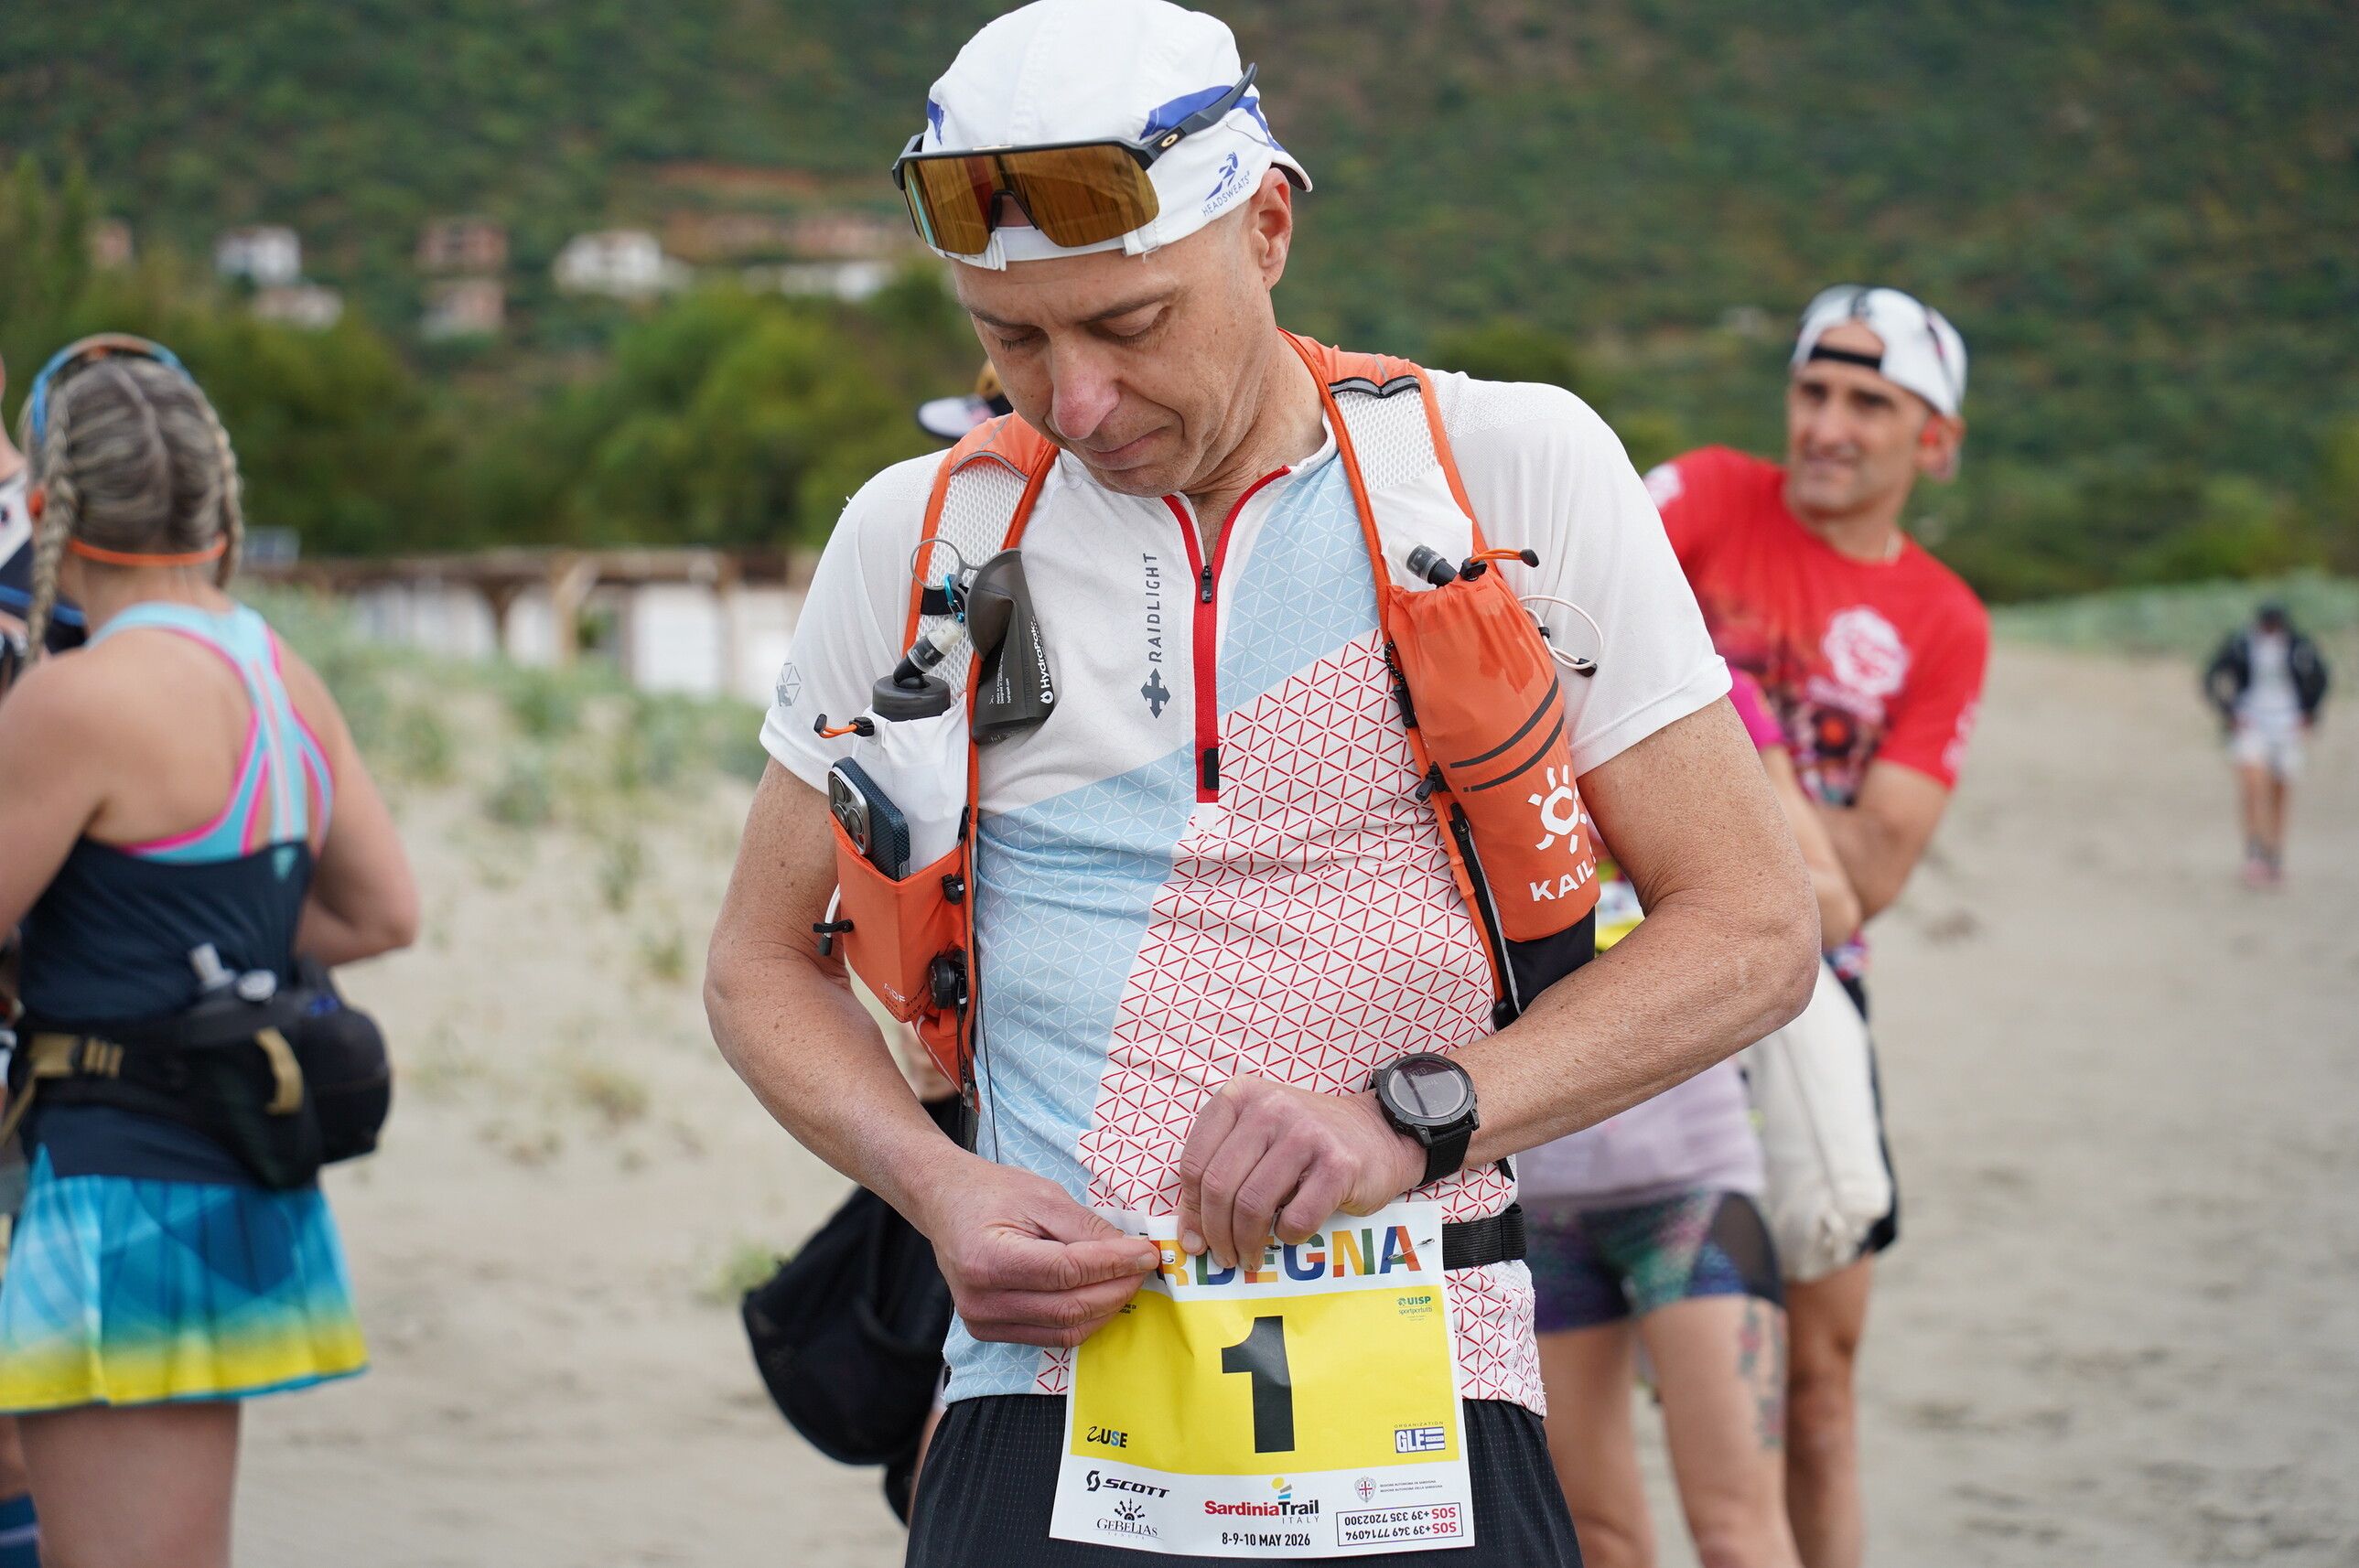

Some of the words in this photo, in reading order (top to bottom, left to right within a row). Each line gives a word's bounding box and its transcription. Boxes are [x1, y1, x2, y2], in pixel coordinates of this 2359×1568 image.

[1201, 176, 1250, 217] HEADSWEATS
[1143, 553, 1162, 663] RAIDLIGHT
[1030, 623, 1051, 689] HydraPak
[1529, 860, 1595, 902] KAIL
[1407, 1296, 1431, 1305] UISP
[1221, 1315, 1296, 1454] 1
[1103, 1477, 1170, 1498] SCOTT
[1282, 1515, 1320, 1524] ITALY
[1390, 1511, 1408, 1523] 335
[1411, 1510, 1429, 1520] +39
[1431, 1507, 1457, 1520] SOS
[1392, 1526, 1410, 1537] 349
[1413, 1525, 1430, 1535] +39
[1432, 1521, 1457, 1534] SOS
[1222, 1531, 1256, 1546] 8-9-10
[1259, 1533, 1282, 1547] MAY
[1285, 1533, 1310, 1547] 2026
